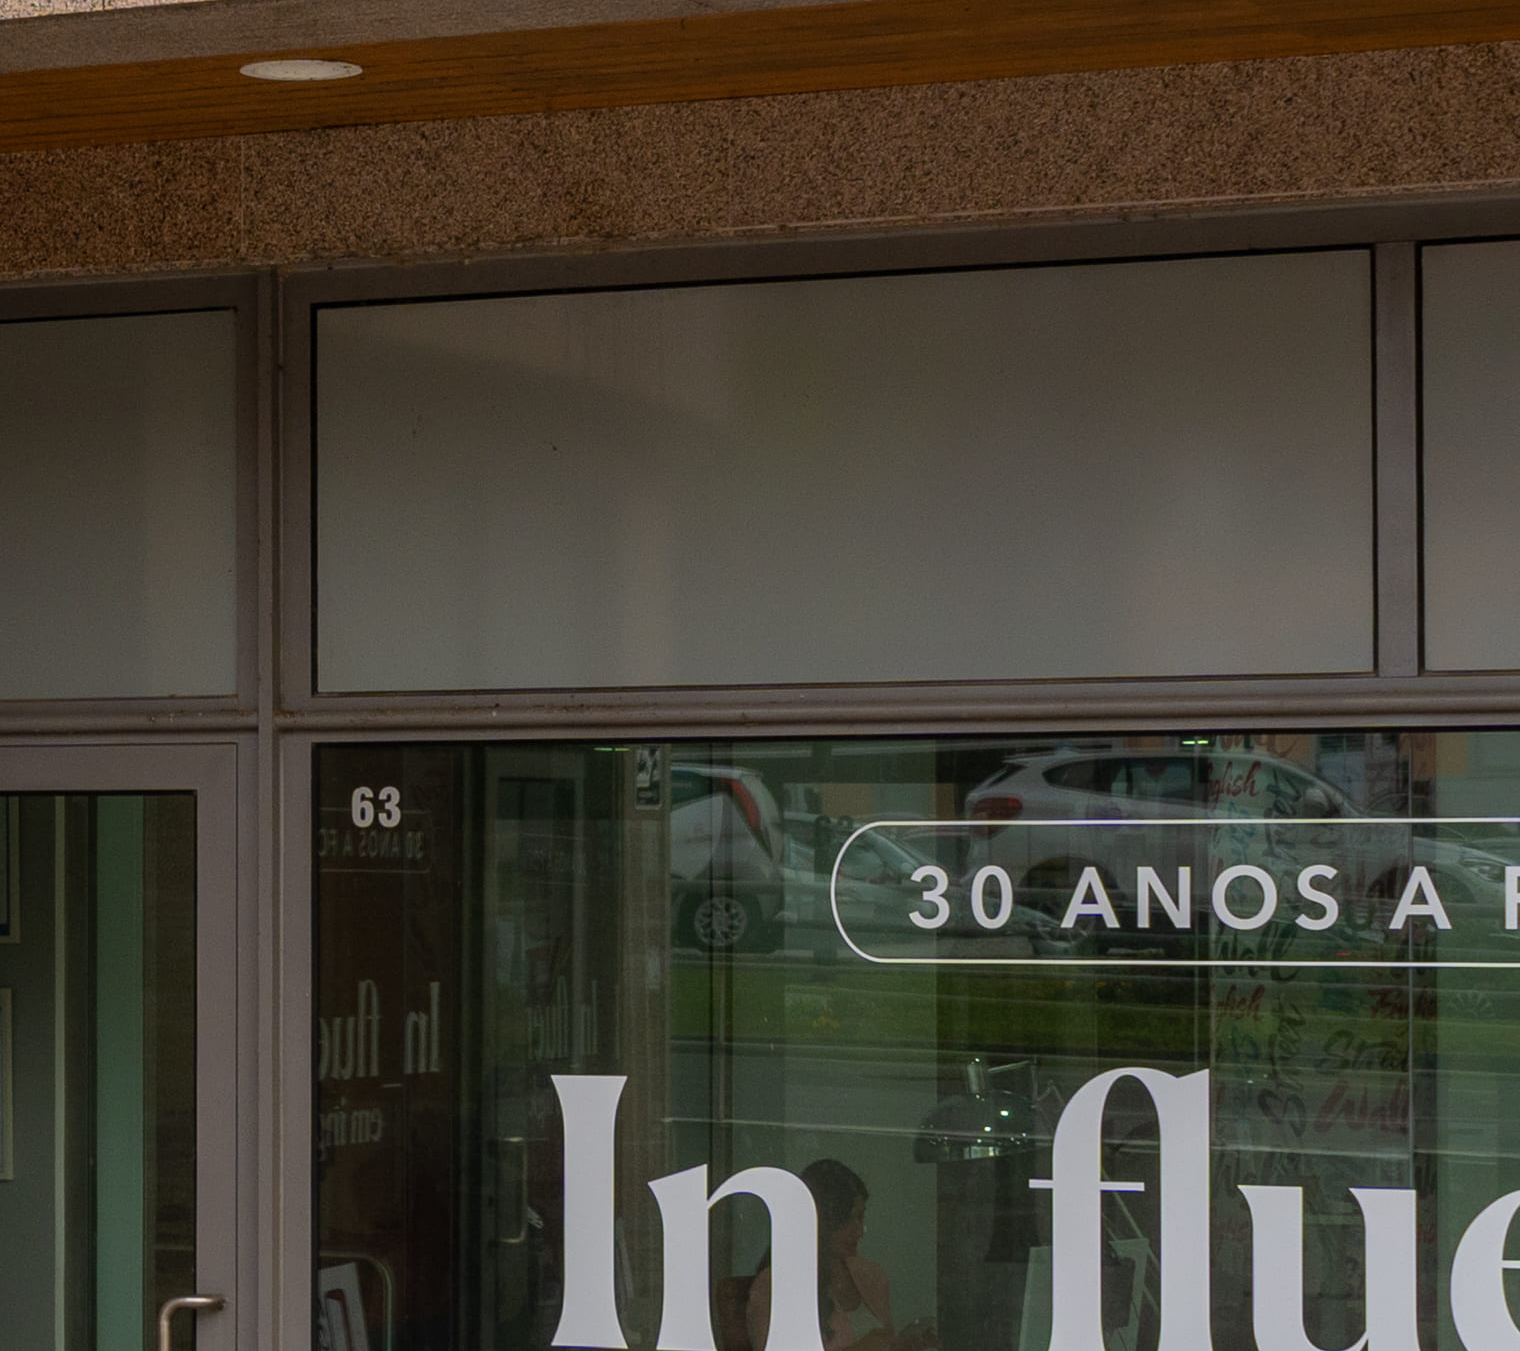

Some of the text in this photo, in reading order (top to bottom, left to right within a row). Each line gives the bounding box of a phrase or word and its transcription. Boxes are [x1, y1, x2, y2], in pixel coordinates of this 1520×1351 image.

[351, 786, 401, 828] 63
[909, 865, 1013, 931] 30
[1060, 865, 1340, 932] ANOS
[1389, 865, 1451, 931] A
